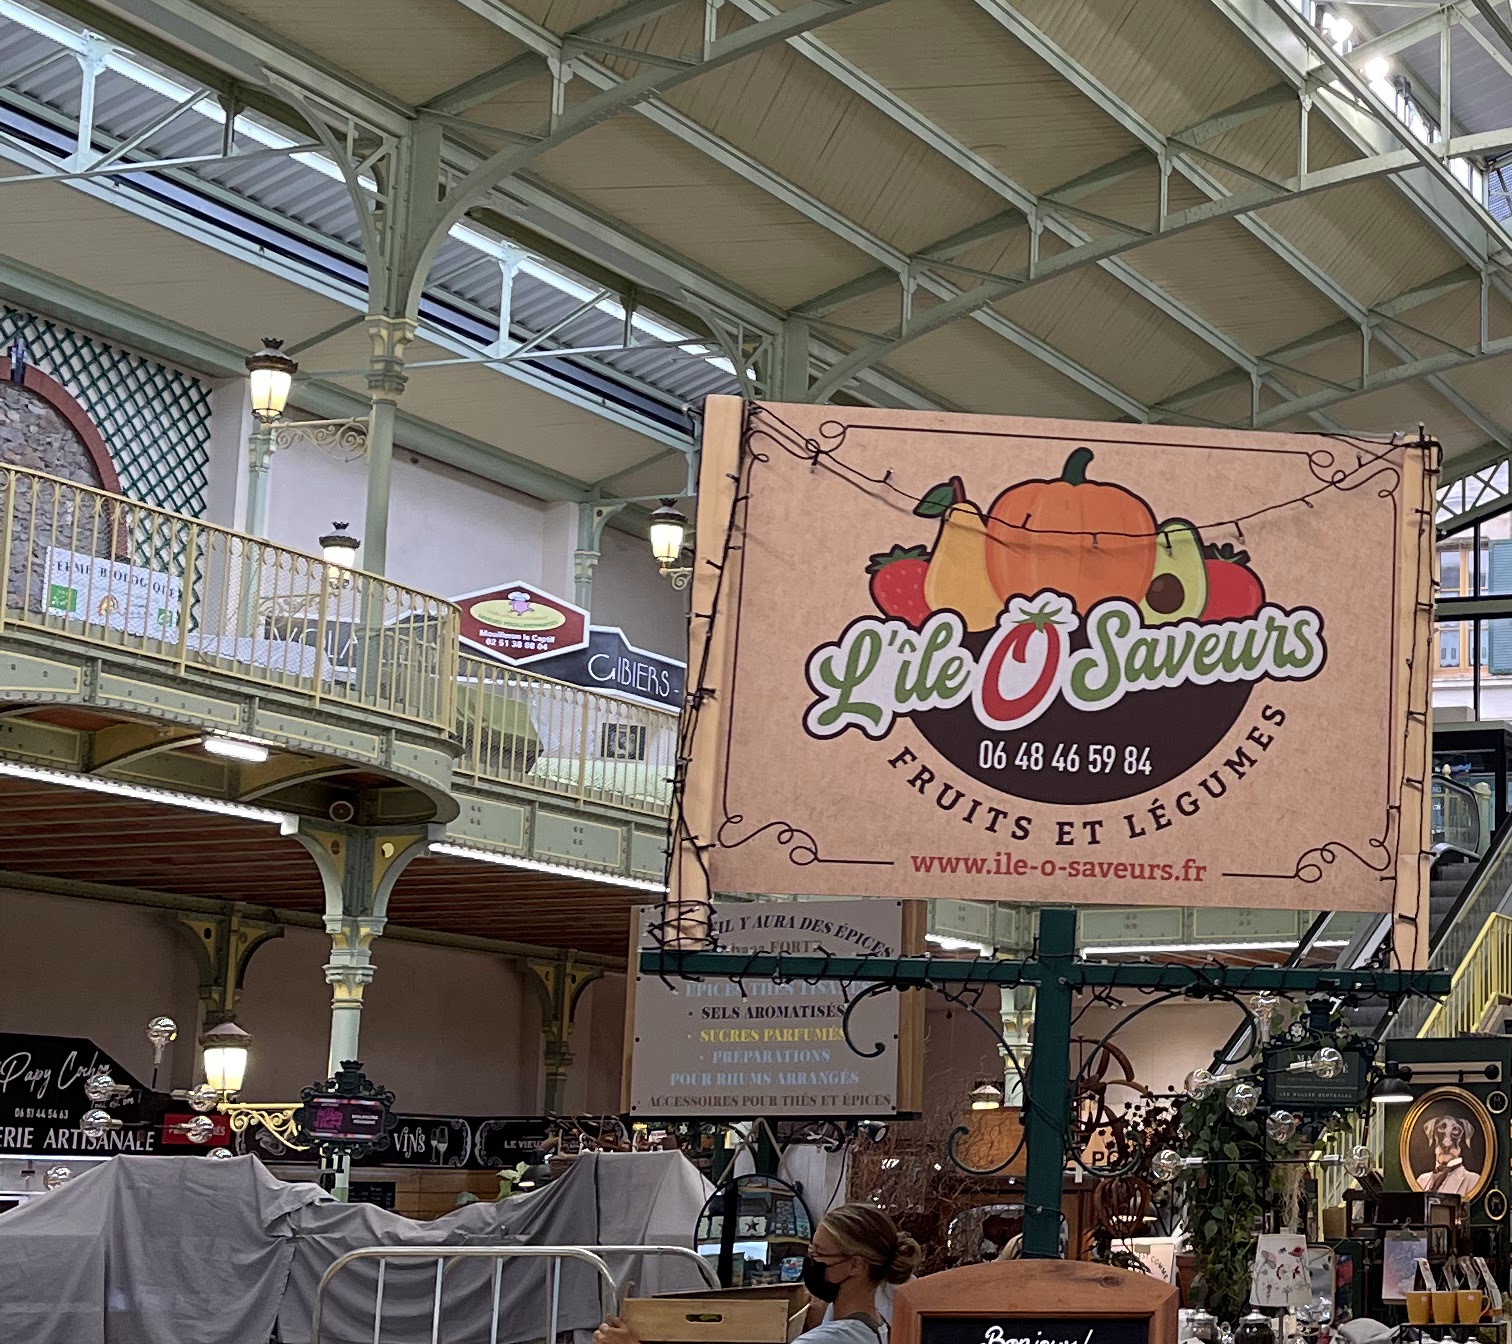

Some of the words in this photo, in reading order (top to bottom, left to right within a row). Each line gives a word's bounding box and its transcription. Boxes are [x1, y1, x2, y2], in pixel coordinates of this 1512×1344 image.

[587, 653, 670, 698] GIBIERS
[820, 620, 970, 728] L'île
[981, 616, 1061, 722] O
[1070, 609, 1314, 703] Saveurs
[979, 740, 1007, 770] 06
[1014, 741, 1043, 772] 48
[1051, 743, 1080, 773] 46
[1088, 744, 1116, 774] 59
[1124, 746, 1153, 776] 84
[886, 744, 1032, 842] FRUITS
[1056, 820, 1104, 847] ET
[1128, 703, 1287, 840] LÉGUMES
[910, 852, 1207, 882] www.ile-o-saveurs.fr
[739, 915, 751, 930] Y
[752, 914, 795, 930] AURA
[799, 914, 833, 935] DES
[833, 921, 895, 958] ÉPICES
[702, 1006, 740, 1020] SELS
[745, 1003, 846, 1020] AROMATISÉS
[700, 1028, 759, 1043] SUCRES
[763, 1024, 846, 1043] PARFUMÉS
[670, 1072, 711, 1087] POUR
[778, 1069, 860, 1086] ARRANGÉS
[650, 1095, 738, 1108] ACCESSOIRES
[742, 1096, 779, 1108] POUR
[821, 1095, 838, 1107] ET
[518, 1140, 543, 1150] VIEU
